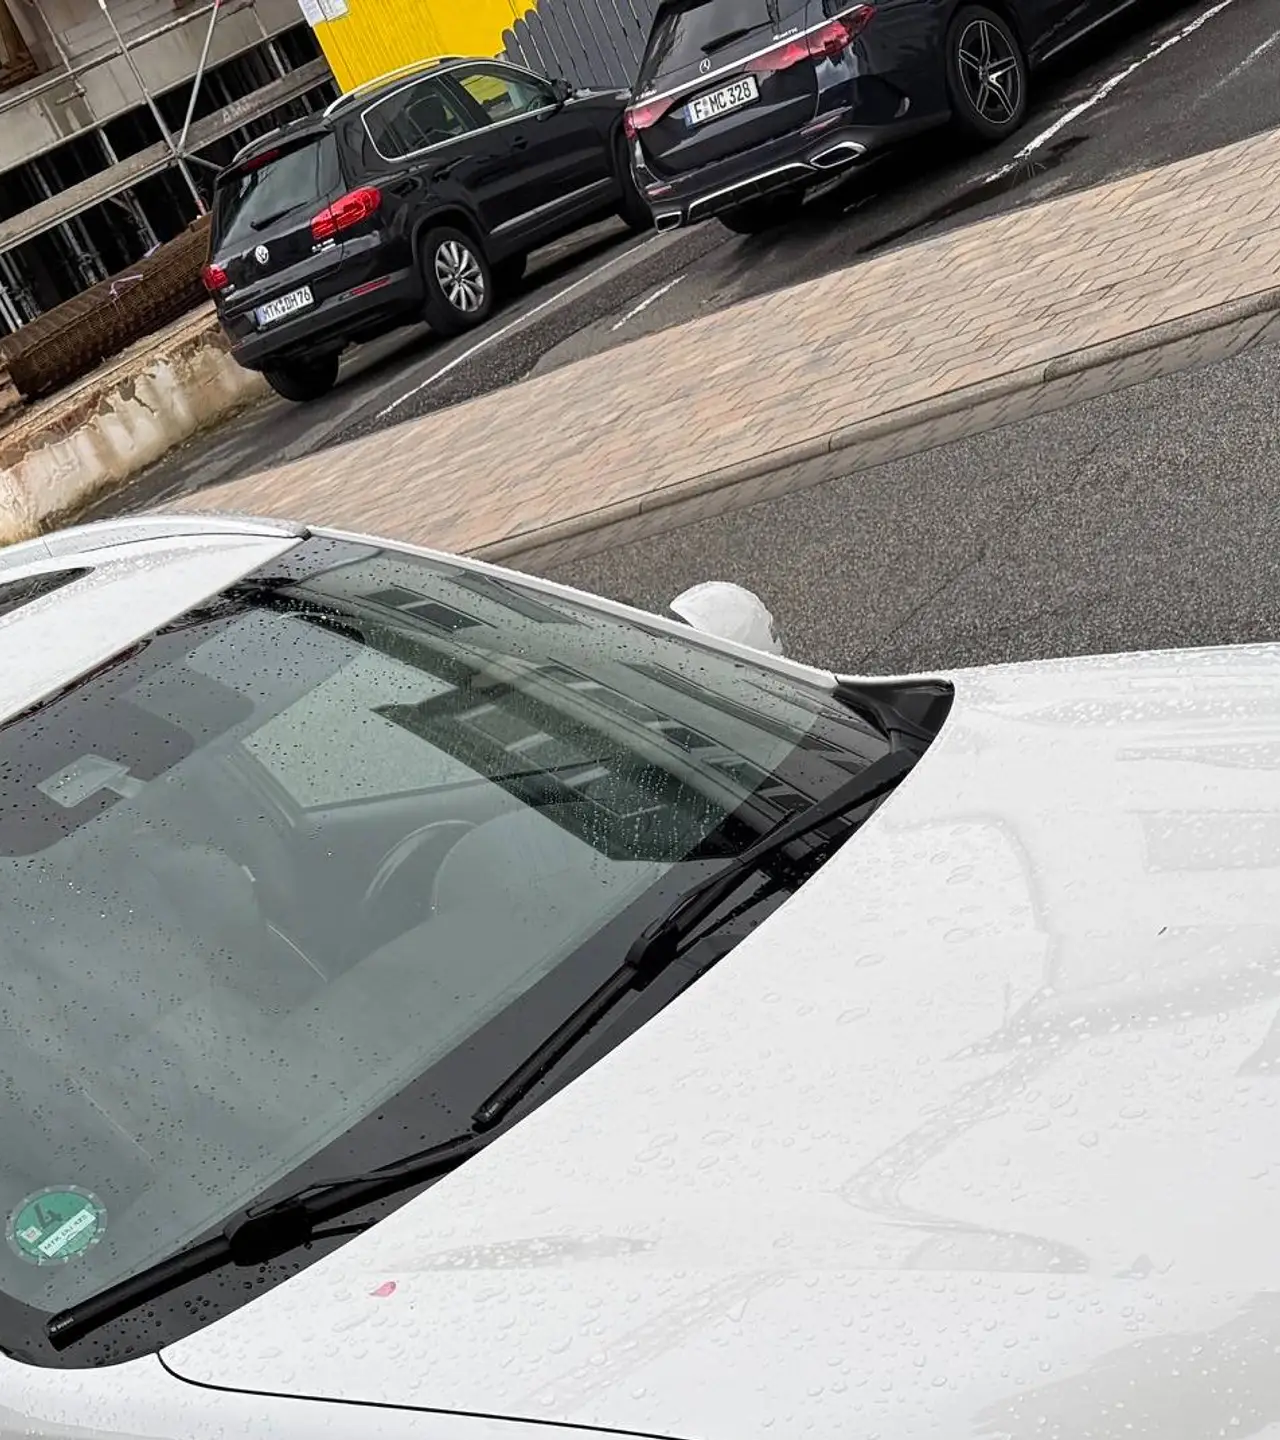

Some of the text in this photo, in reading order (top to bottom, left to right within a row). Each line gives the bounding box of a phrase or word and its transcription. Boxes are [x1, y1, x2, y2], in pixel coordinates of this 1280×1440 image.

[693, 82, 752, 119] F MC 328
